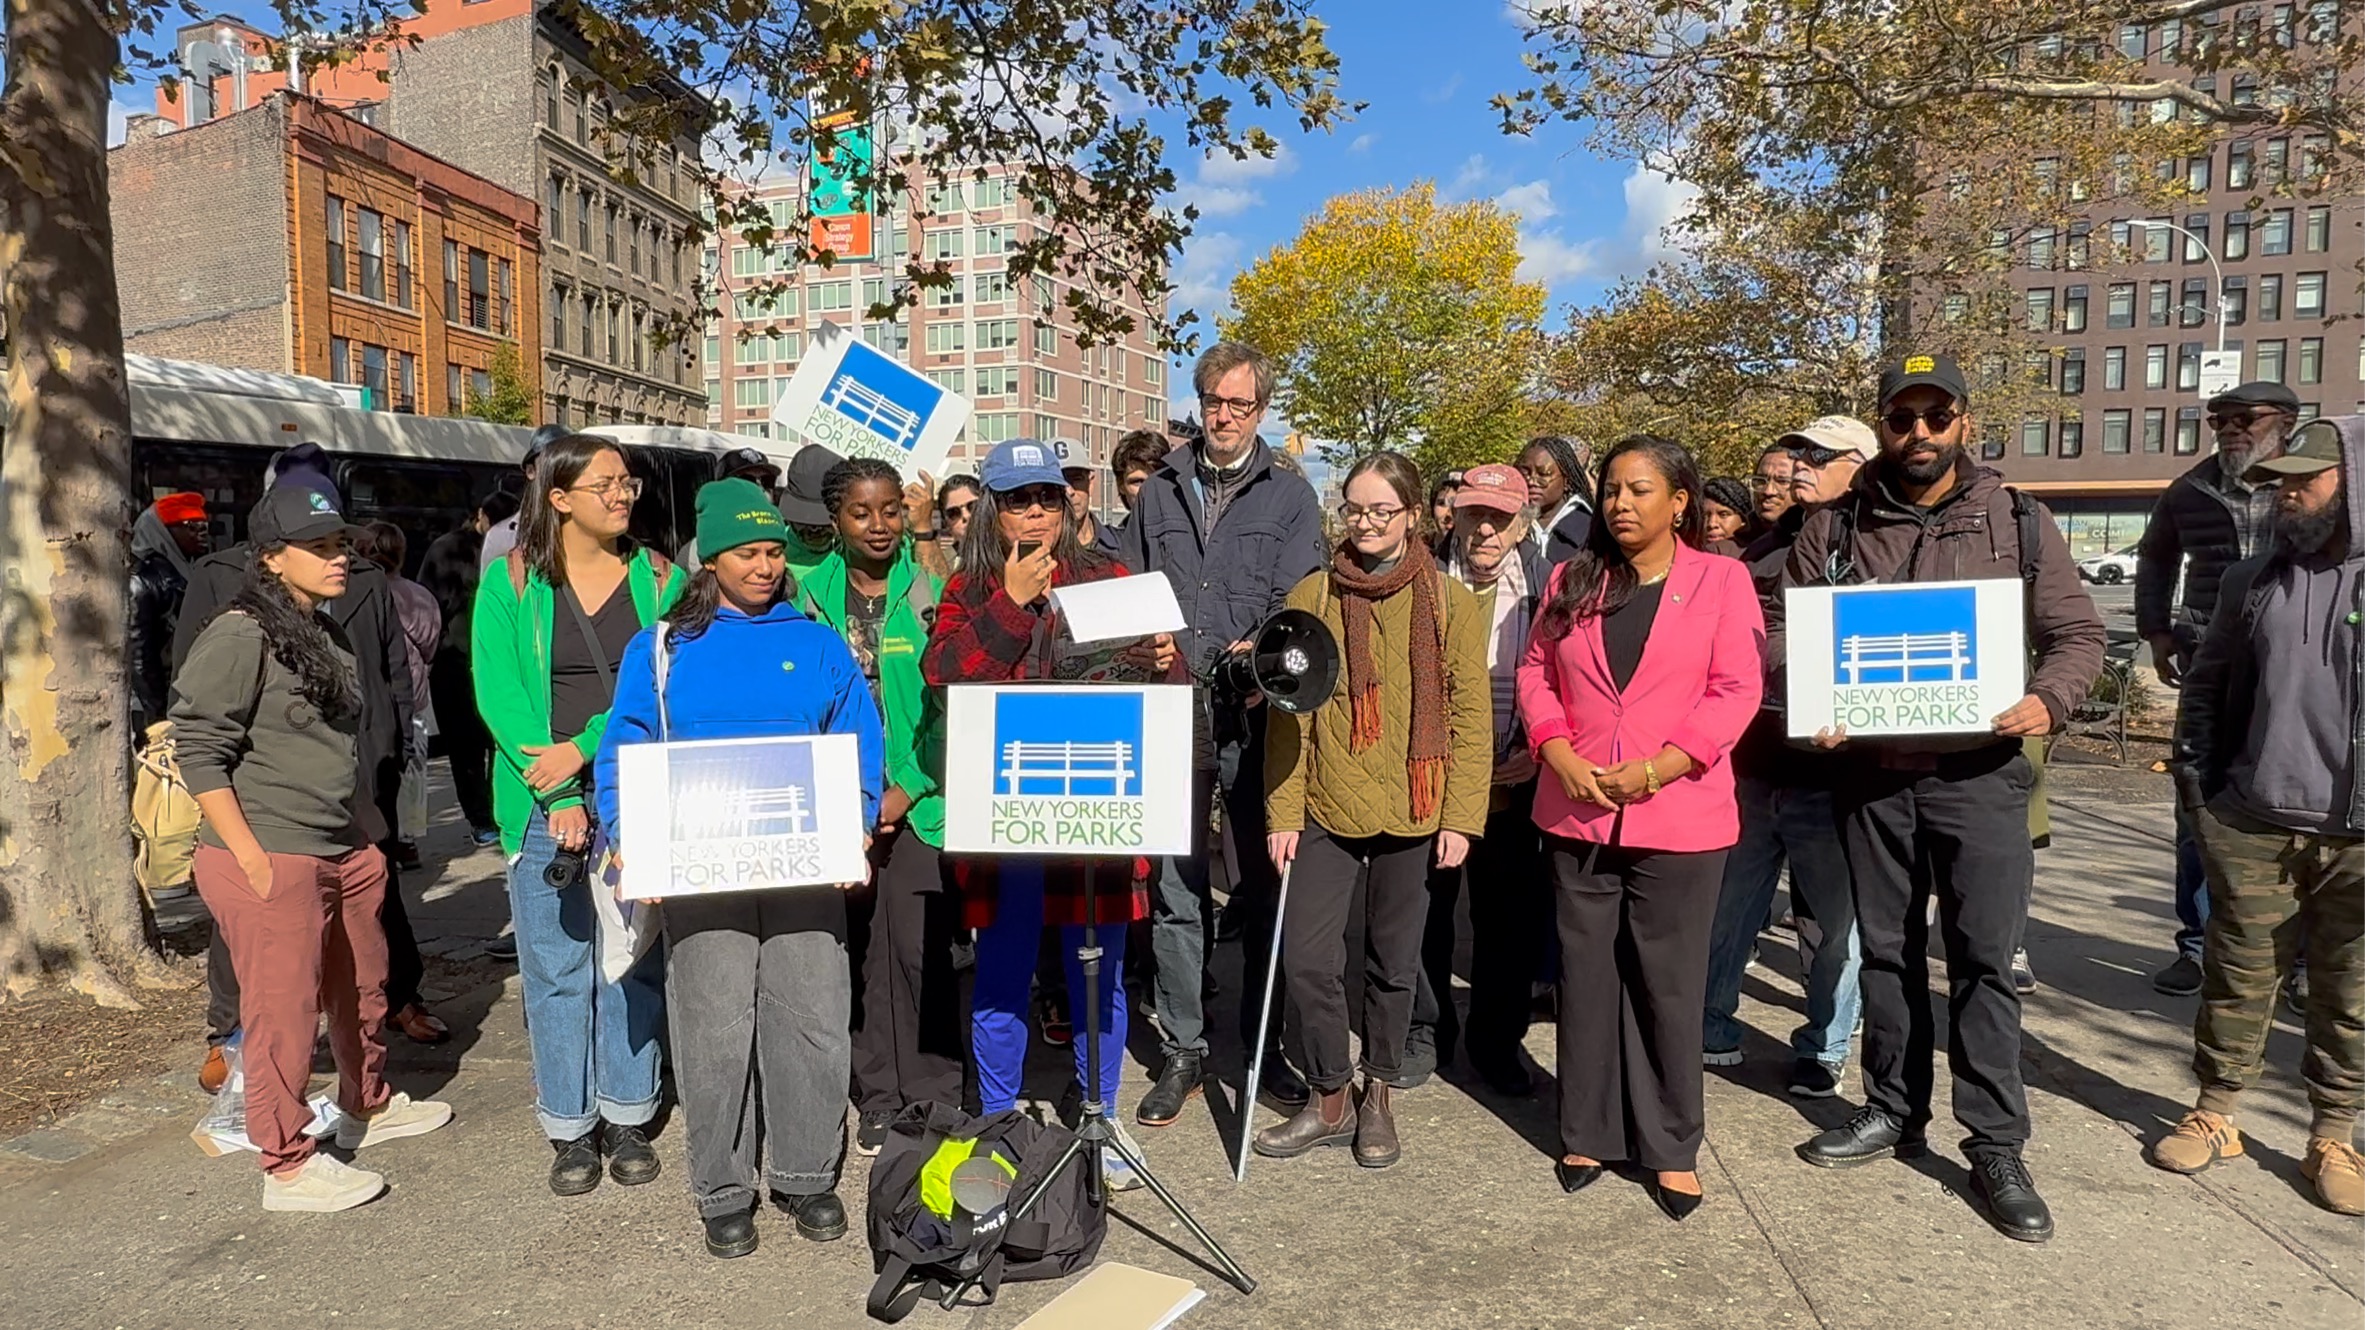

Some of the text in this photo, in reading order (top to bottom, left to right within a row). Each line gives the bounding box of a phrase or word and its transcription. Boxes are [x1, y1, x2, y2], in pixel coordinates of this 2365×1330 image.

[804, 416, 843, 449] FOR
[812, 404, 909, 465] NEW YORKERS
[1053, 440, 1070, 460] G
[1833, 684, 1980, 705] NEW YORKERS
[1833, 702, 1980, 729] FOR PARKS
[991, 799, 1144, 820] NEW YORKERS
[991, 819, 1144, 847] FOR PARKS
[669, 836, 821, 864] NEW YORKERS
[670, 855, 822, 888] FOR PARKS
